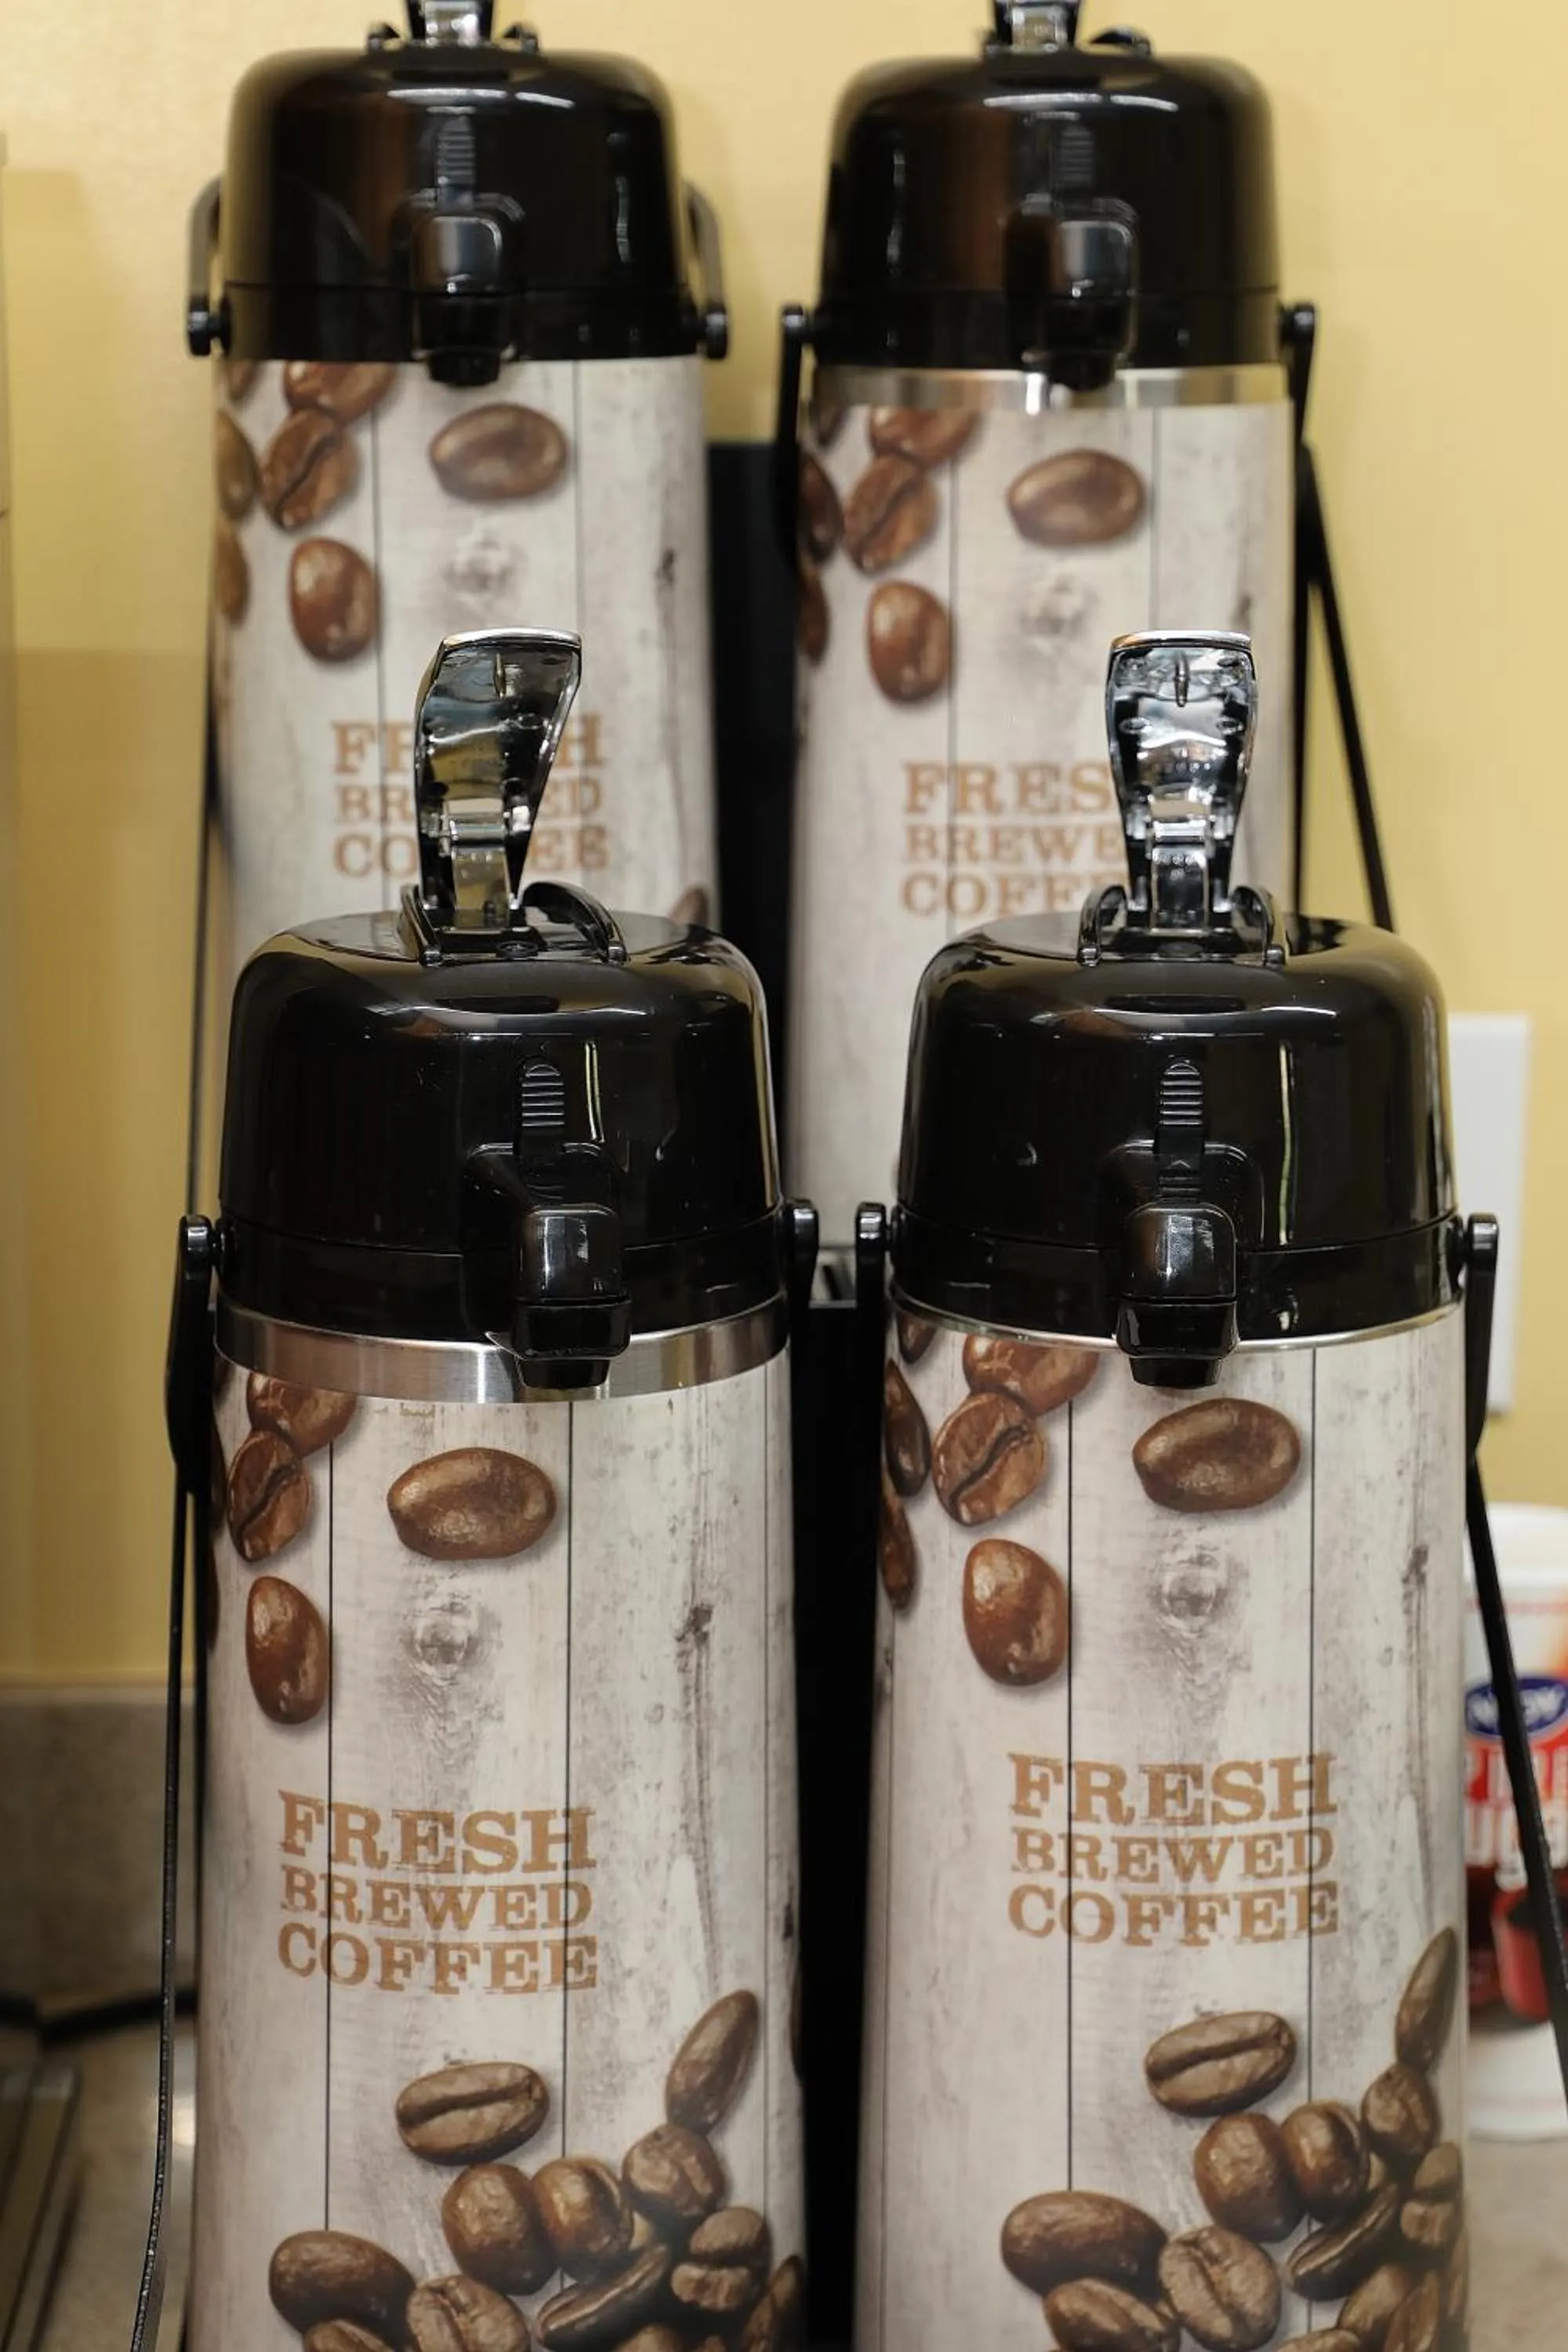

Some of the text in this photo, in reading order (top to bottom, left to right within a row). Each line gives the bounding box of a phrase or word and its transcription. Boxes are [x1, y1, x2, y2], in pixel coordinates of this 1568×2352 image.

[902, 760, 1112, 815] FRES
[334, 826, 608, 877] COEE
[904, 823, 1123, 863] BREWE
[1007, 1751, 1338, 1826] FRESH
[278, 1789, 597, 1875] FRESH
[1010, 1825, 1334, 1883] BREWED
[280, 1864, 593, 1932] BREWED
[1007, 1880, 1338, 1947] COFFEE
[278, 1921, 597, 1995] COFFEE
